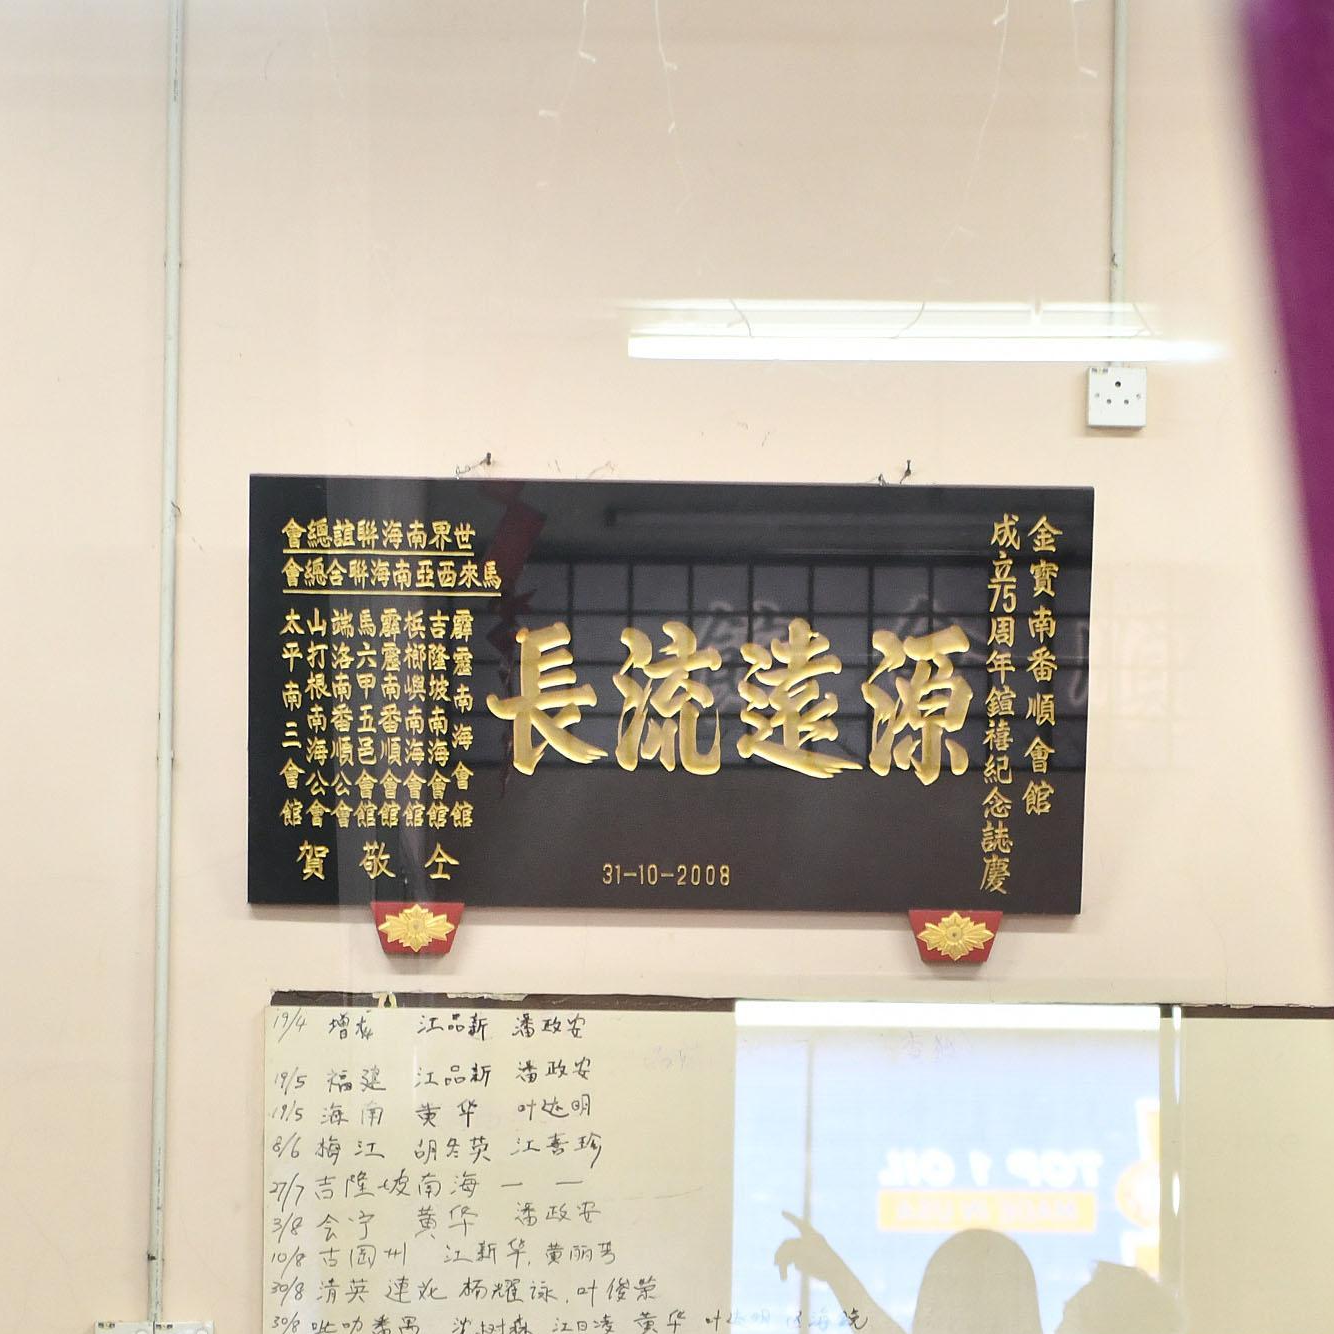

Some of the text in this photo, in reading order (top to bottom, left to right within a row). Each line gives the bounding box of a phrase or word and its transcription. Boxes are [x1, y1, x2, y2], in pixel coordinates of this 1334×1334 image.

[1022, 514, 1062, 815] 金寶南番順會館
[279, 608, 305, 828] 太平南三會館
[305, 607, 331, 828] 山打根南海公會
[354, 609, 378, 829] 馬六甲五邑會館
[426, 609, 451, 829] 吉隆坡南海會館
[602, 863, 732, 887] 31-10-2008
[417, 1013, 490, 1041] 江品新
[512, 1013, 587, 1040] 潘政安
[326, 1065, 387, 1093] 福建
[414, 1063, 492, 1088] 江品新
[516, 1056, 591, 1084] 潘政安
[321, 1098, 384, 1127] 海南
[518, 1094, 592, 1122] 叶达明
[314, 1136, 386, 1166] 梅江
[414, 1136, 492, 1164] 胡冬英
[515, 1201, 602, 1227] 潘政安
[271, 1246, 307, 1279] 10/8
[270, 1277, 305, 1306] 30/8
